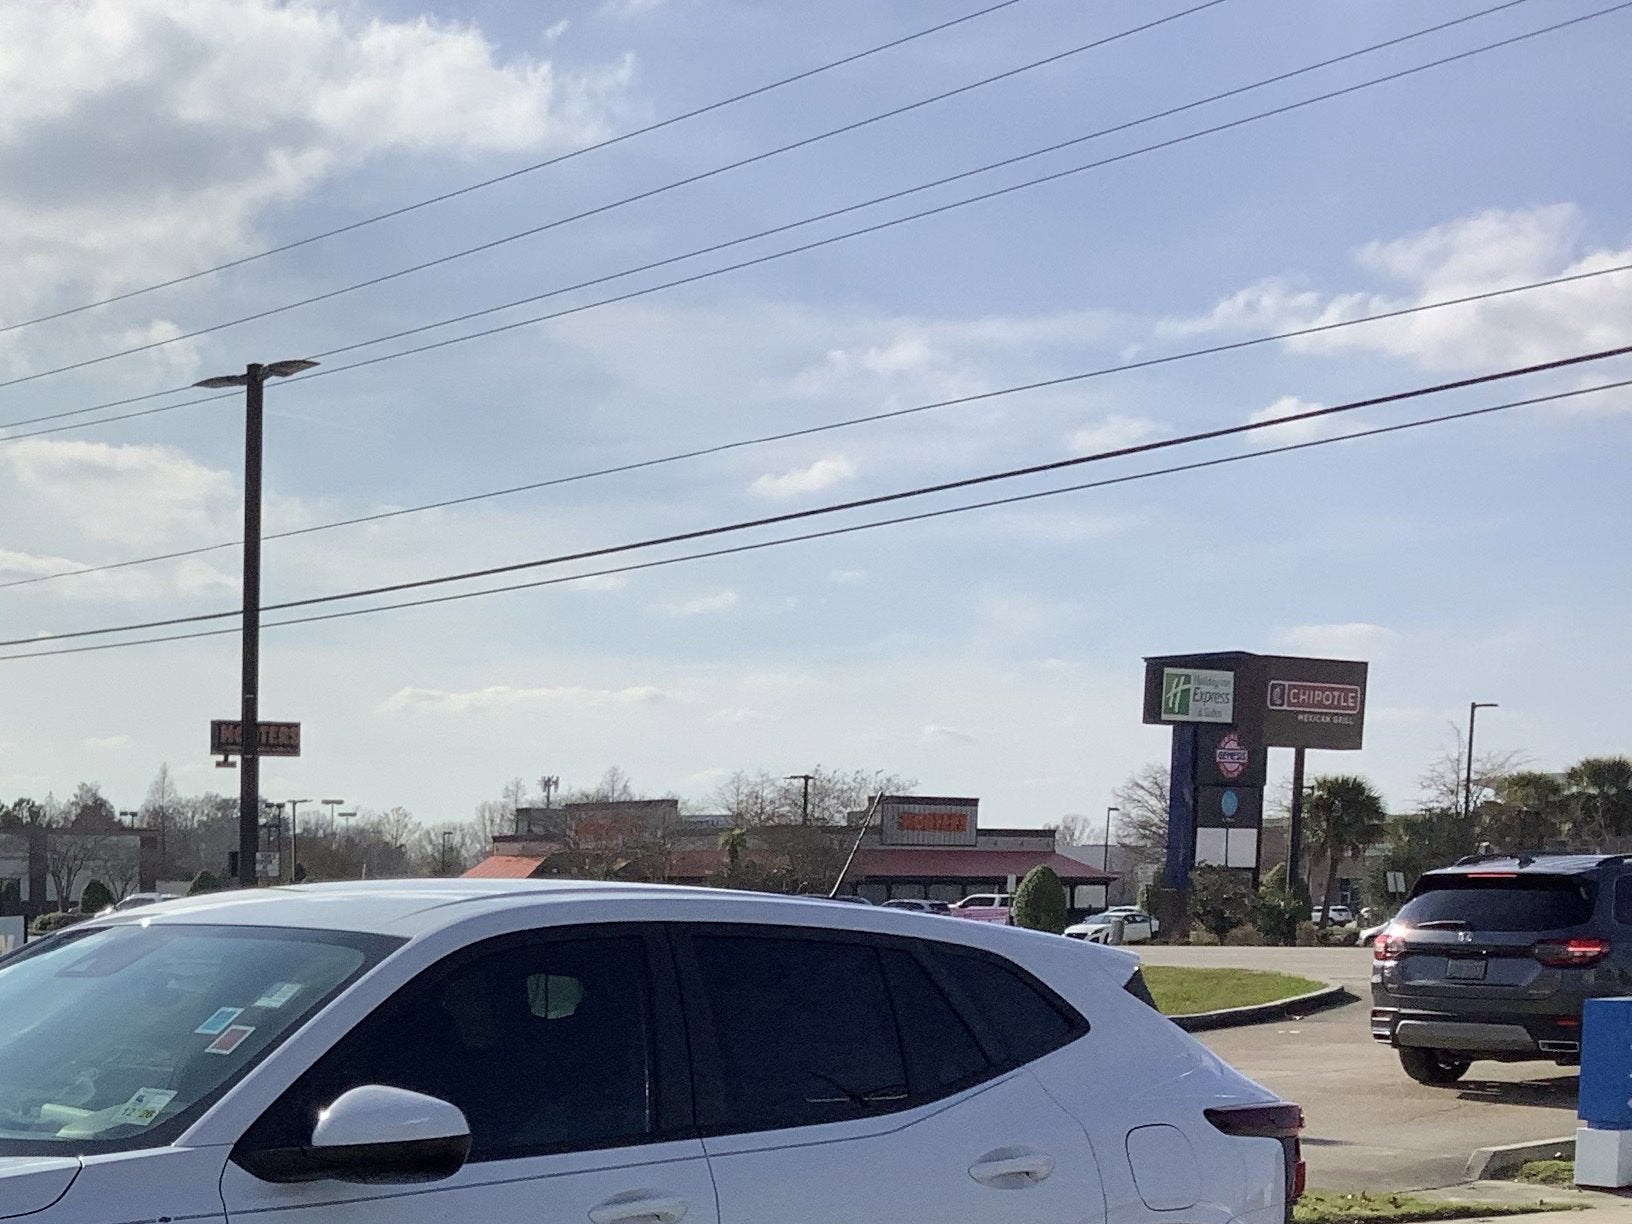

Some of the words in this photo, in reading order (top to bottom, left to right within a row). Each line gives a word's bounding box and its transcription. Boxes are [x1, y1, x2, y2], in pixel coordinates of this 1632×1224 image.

[1192, 686, 1230, 706] Express
[1289, 688, 1356, 707] CHIPOTLE
[1298, 713, 1331, 723] MEXICAN
